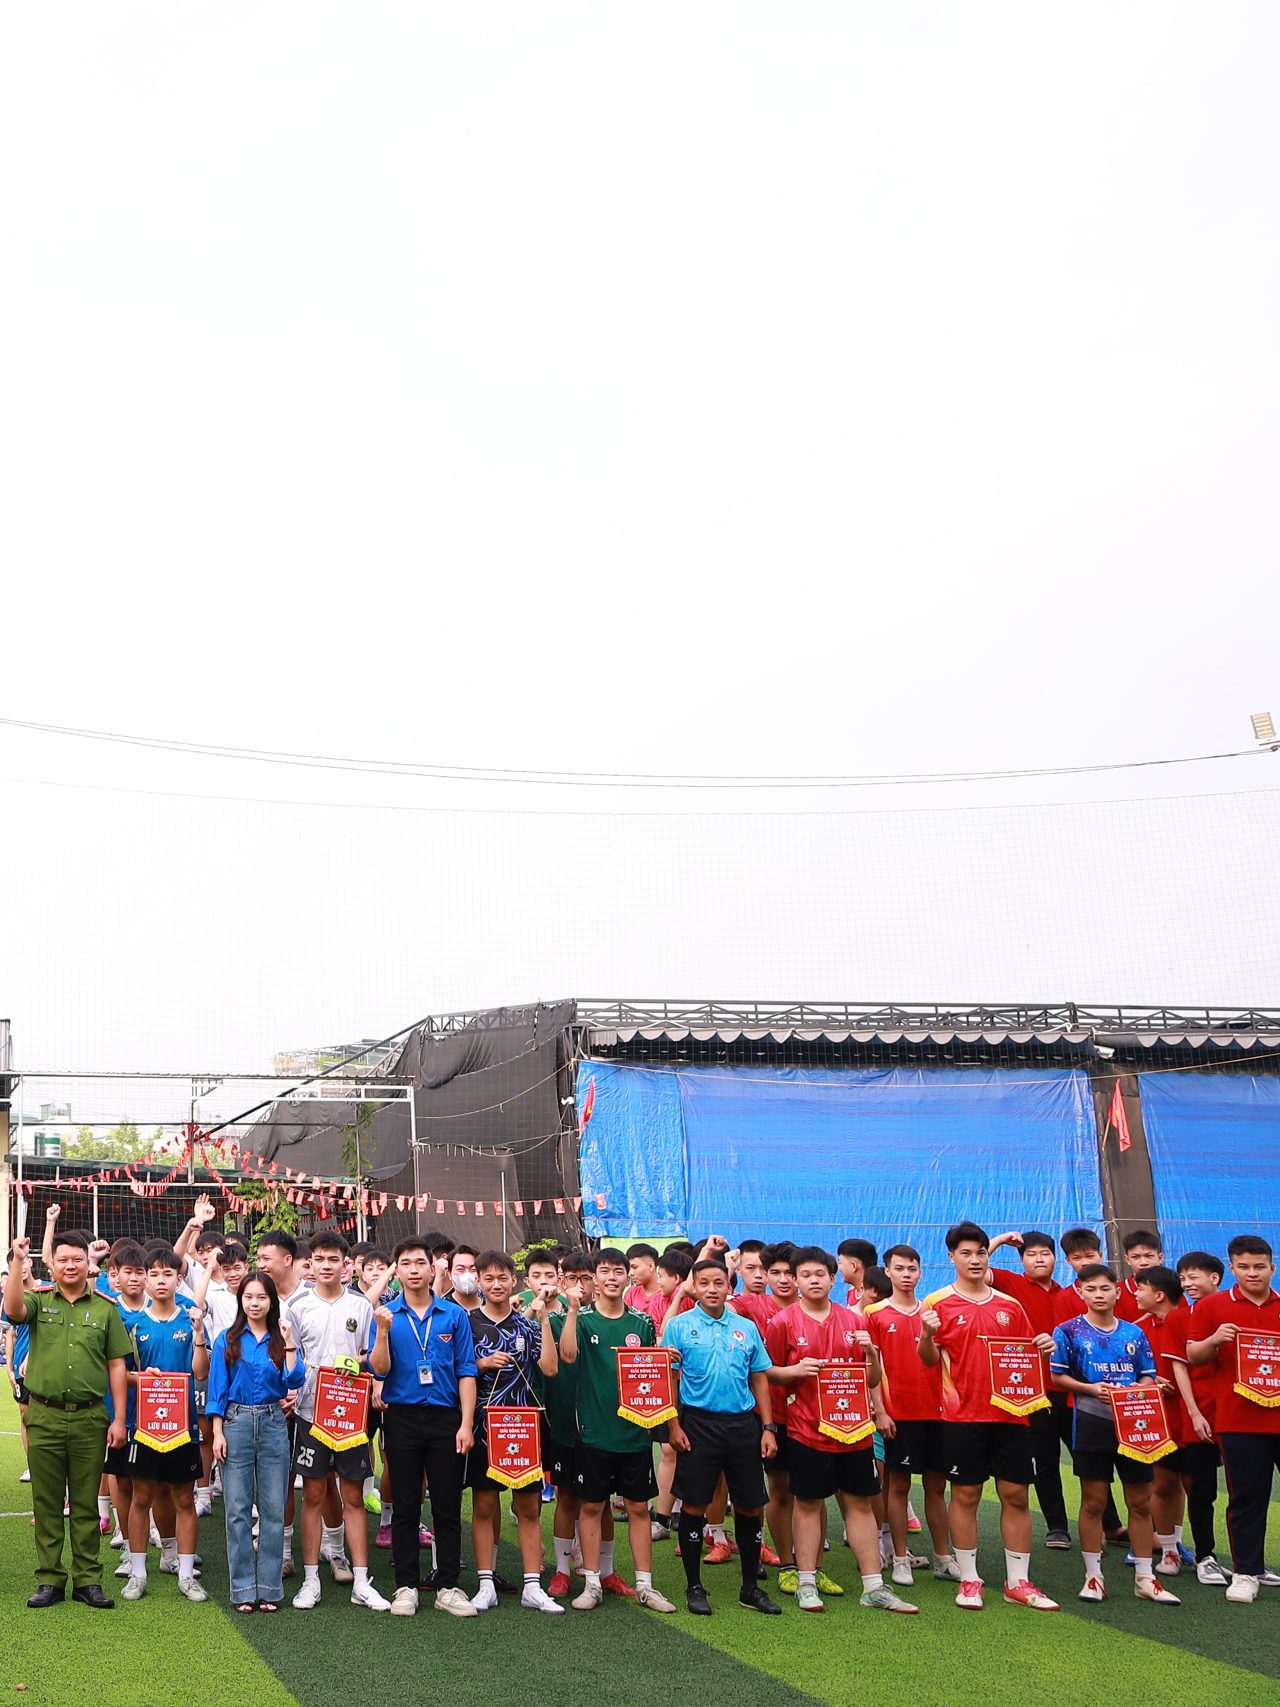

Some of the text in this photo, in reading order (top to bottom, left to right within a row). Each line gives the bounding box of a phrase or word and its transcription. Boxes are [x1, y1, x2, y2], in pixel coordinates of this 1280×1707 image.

[344, 1358, 354, 1368] C
[1092, 1362, 1134, 1372] THE BLUES
[1249, 1377, 1280, 1387] LƯU NIỆ
[1001, 1386, 1034, 1396] LƯU NIỆM
[195, 1391, 206, 1406] 21
[630, 1396, 662, 1406] LƯU NIỆM
[829, 1412, 861, 1422] LƯU NIỆM
[148, 1421, 178, 1431] LƯU NIỆM
[324, 1418, 355, 1431] LƯU NIỆM
[1128, 1432, 1160, 1442] LƯU NIỆM
[296, 1446, 315, 1468] 25
[499, 1456, 530, 1467] LƯU NIỆM
